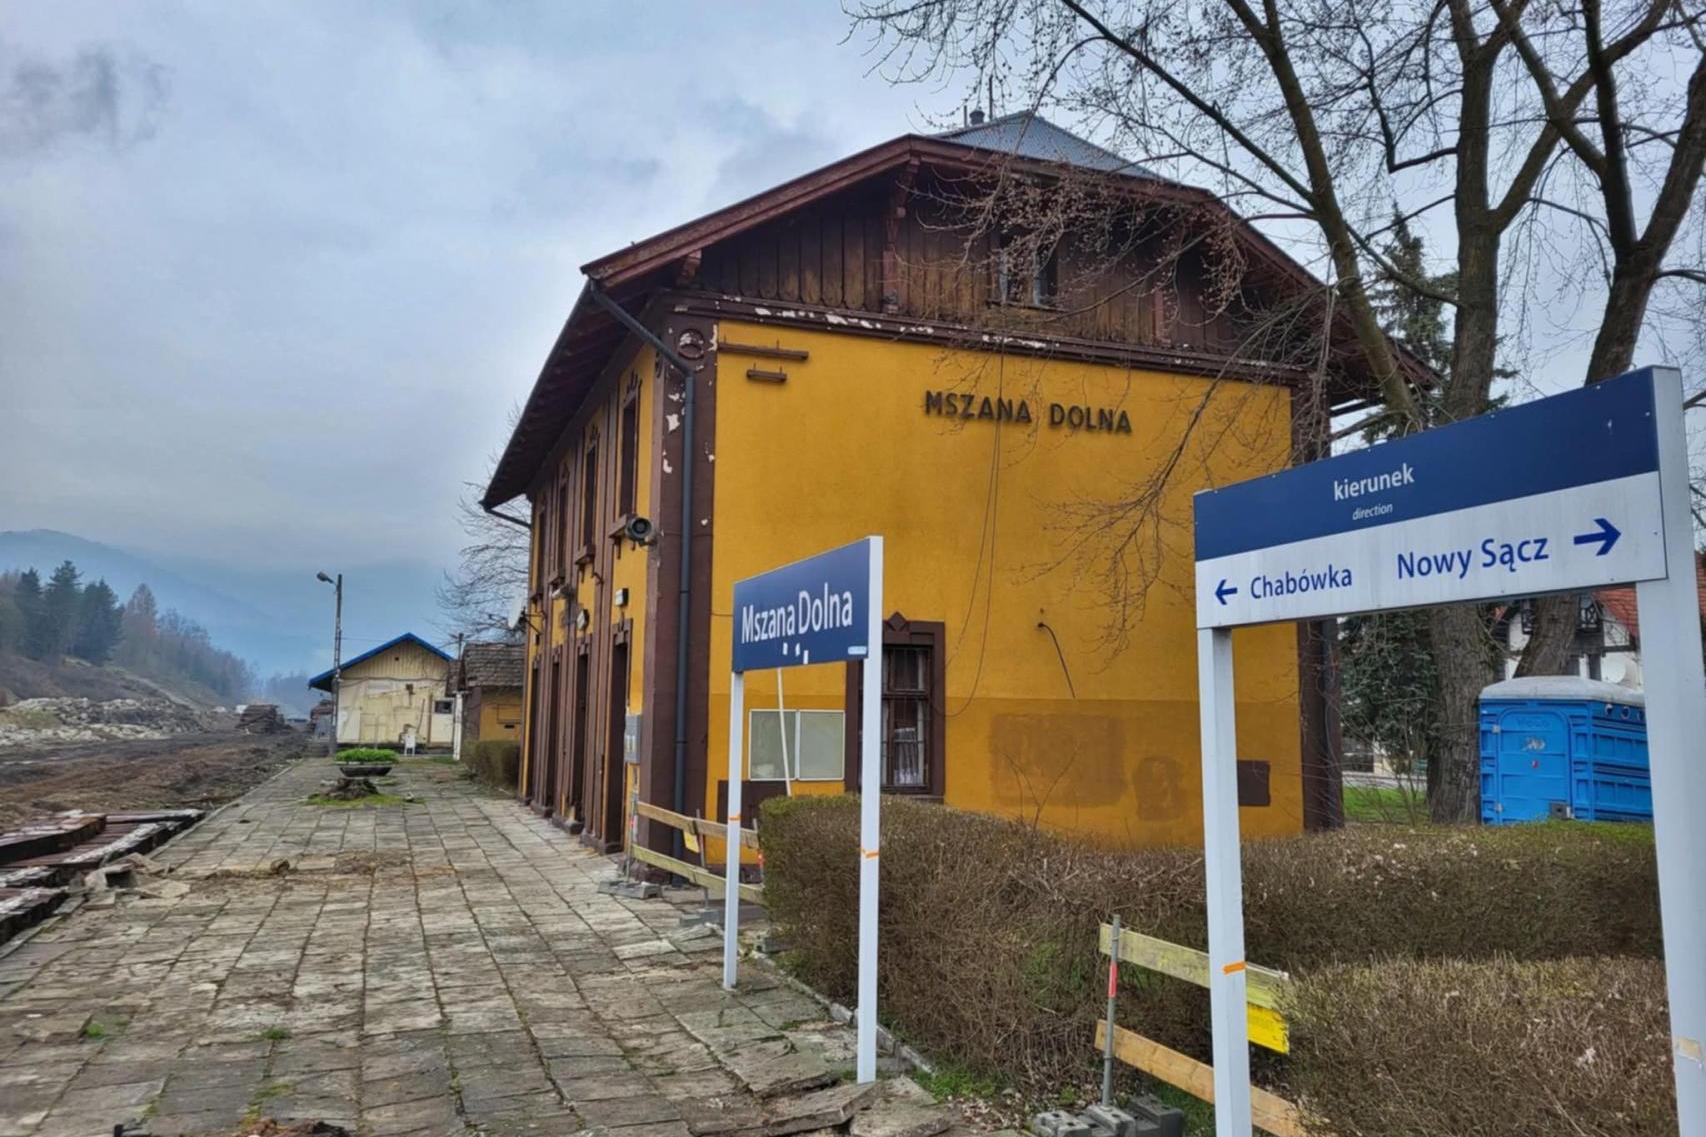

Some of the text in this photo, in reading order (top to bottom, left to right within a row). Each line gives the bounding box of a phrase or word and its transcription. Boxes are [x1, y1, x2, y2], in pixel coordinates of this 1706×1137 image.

[925, 390, 1132, 434] MSZANA DOLNA
[1334, 462, 1415, 501] kierunek
[1352, 503, 1393, 520] direction
[1397, 537, 1549, 580] Nowy Sącz
[1250, 564, 1352, 600] Chabówka
[741, 582, 853, 644] Mszana Dolna
